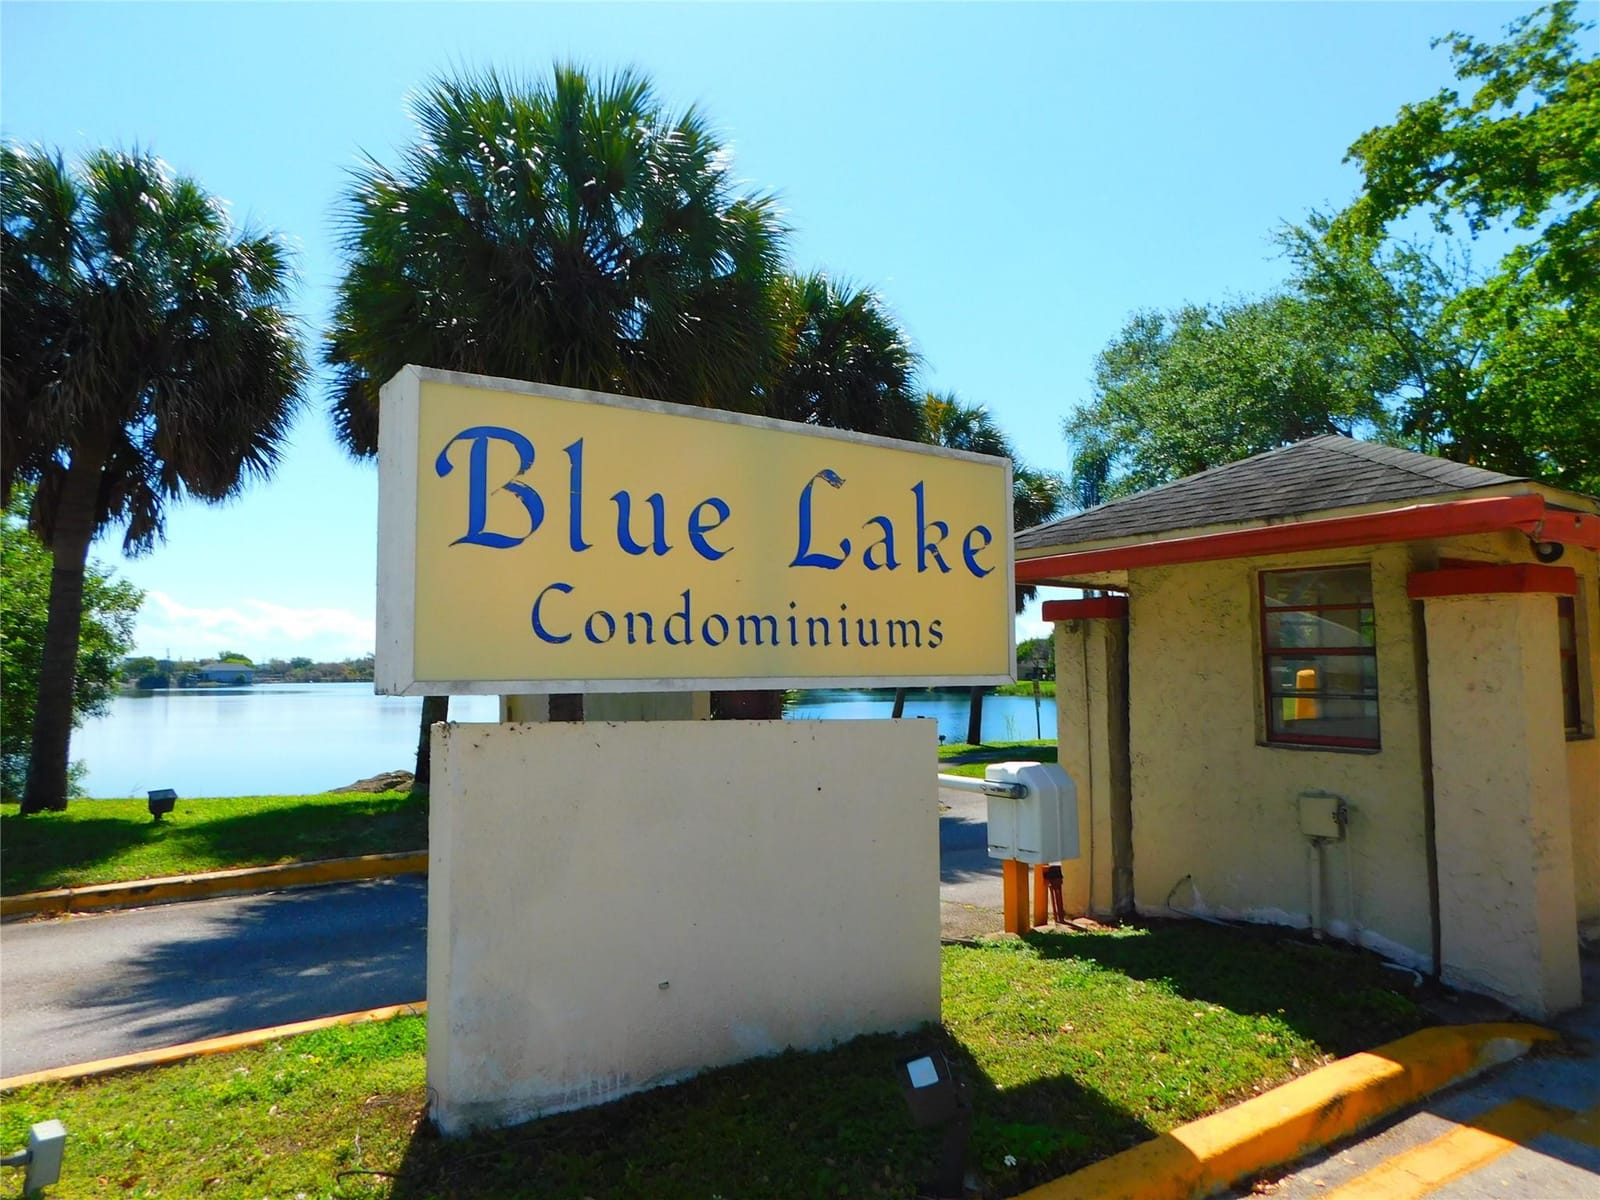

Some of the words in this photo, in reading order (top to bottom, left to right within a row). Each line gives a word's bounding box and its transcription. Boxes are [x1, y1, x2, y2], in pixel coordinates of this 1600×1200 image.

[435, 426, 734, 560] Blue
[789, 469, 996, 577] Lake
[531, 583, 944, 647] Condominiums
